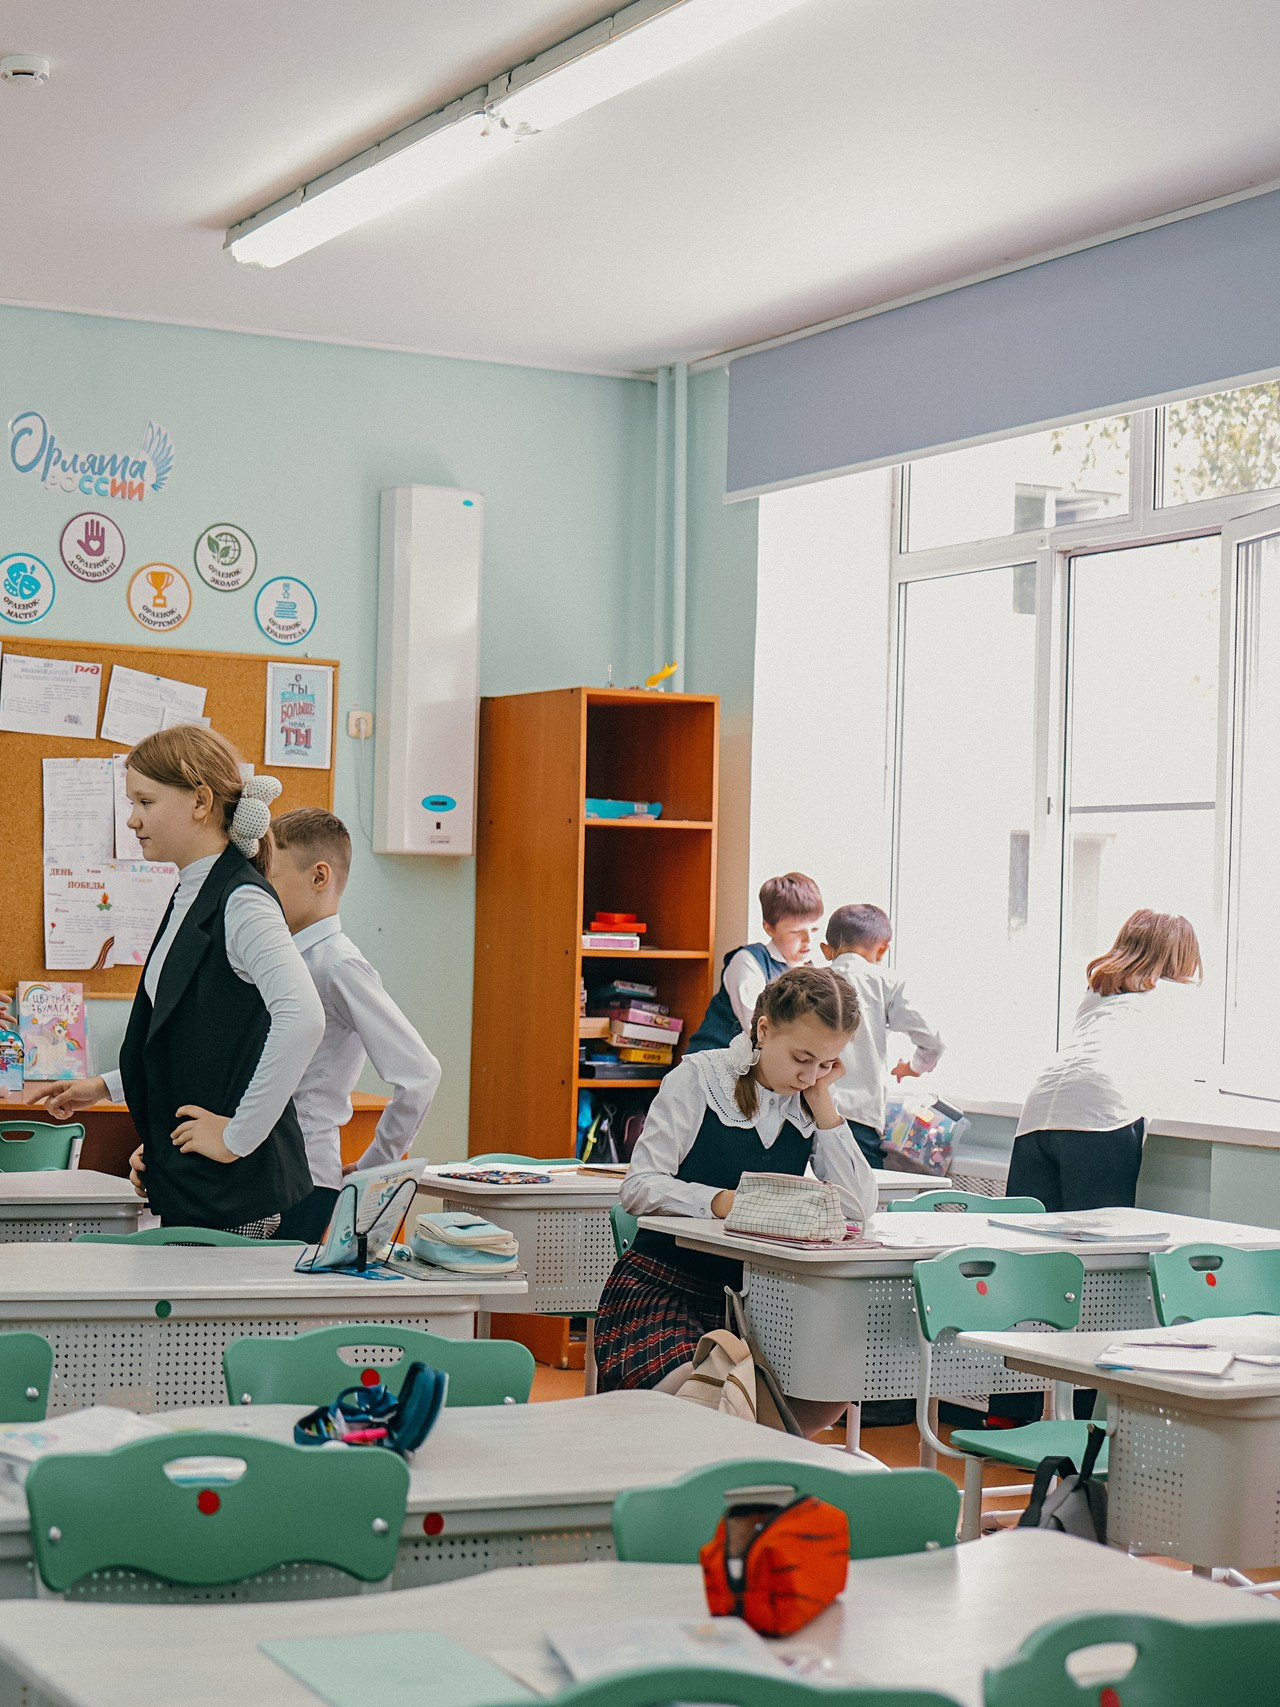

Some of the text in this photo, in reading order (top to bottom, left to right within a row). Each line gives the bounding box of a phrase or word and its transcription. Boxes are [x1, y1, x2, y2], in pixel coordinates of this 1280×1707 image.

[11, 411, 147, 482] Орлята
[68, 560, 117, 578] ДОБРОВОЛЕЦ
[210, 577, 240, 587] ЭКОЛОГ
[6, 609, 38, 619] МАСТЕР
[138, 613, 182, 628] СПОРТСМЕН
[265, 625, 307, 640] ХРАНИТЕЛЬ
[288, 683, 308, 695] ТЫ
[281, 702, 316, 723] БОЛЬШЕ
[281, 726, 312, 748] ТЫ
[50, 868, 73, 876] ДЕНЬ
[139, 865, 175, 874] РОССИИ
[68, 881, 106, 890] ПОБЕДЫ
[32, 993, 72, 1005] ЦВЕТНАЯ
[37, 1003, 70, 1014] БУМАГА
